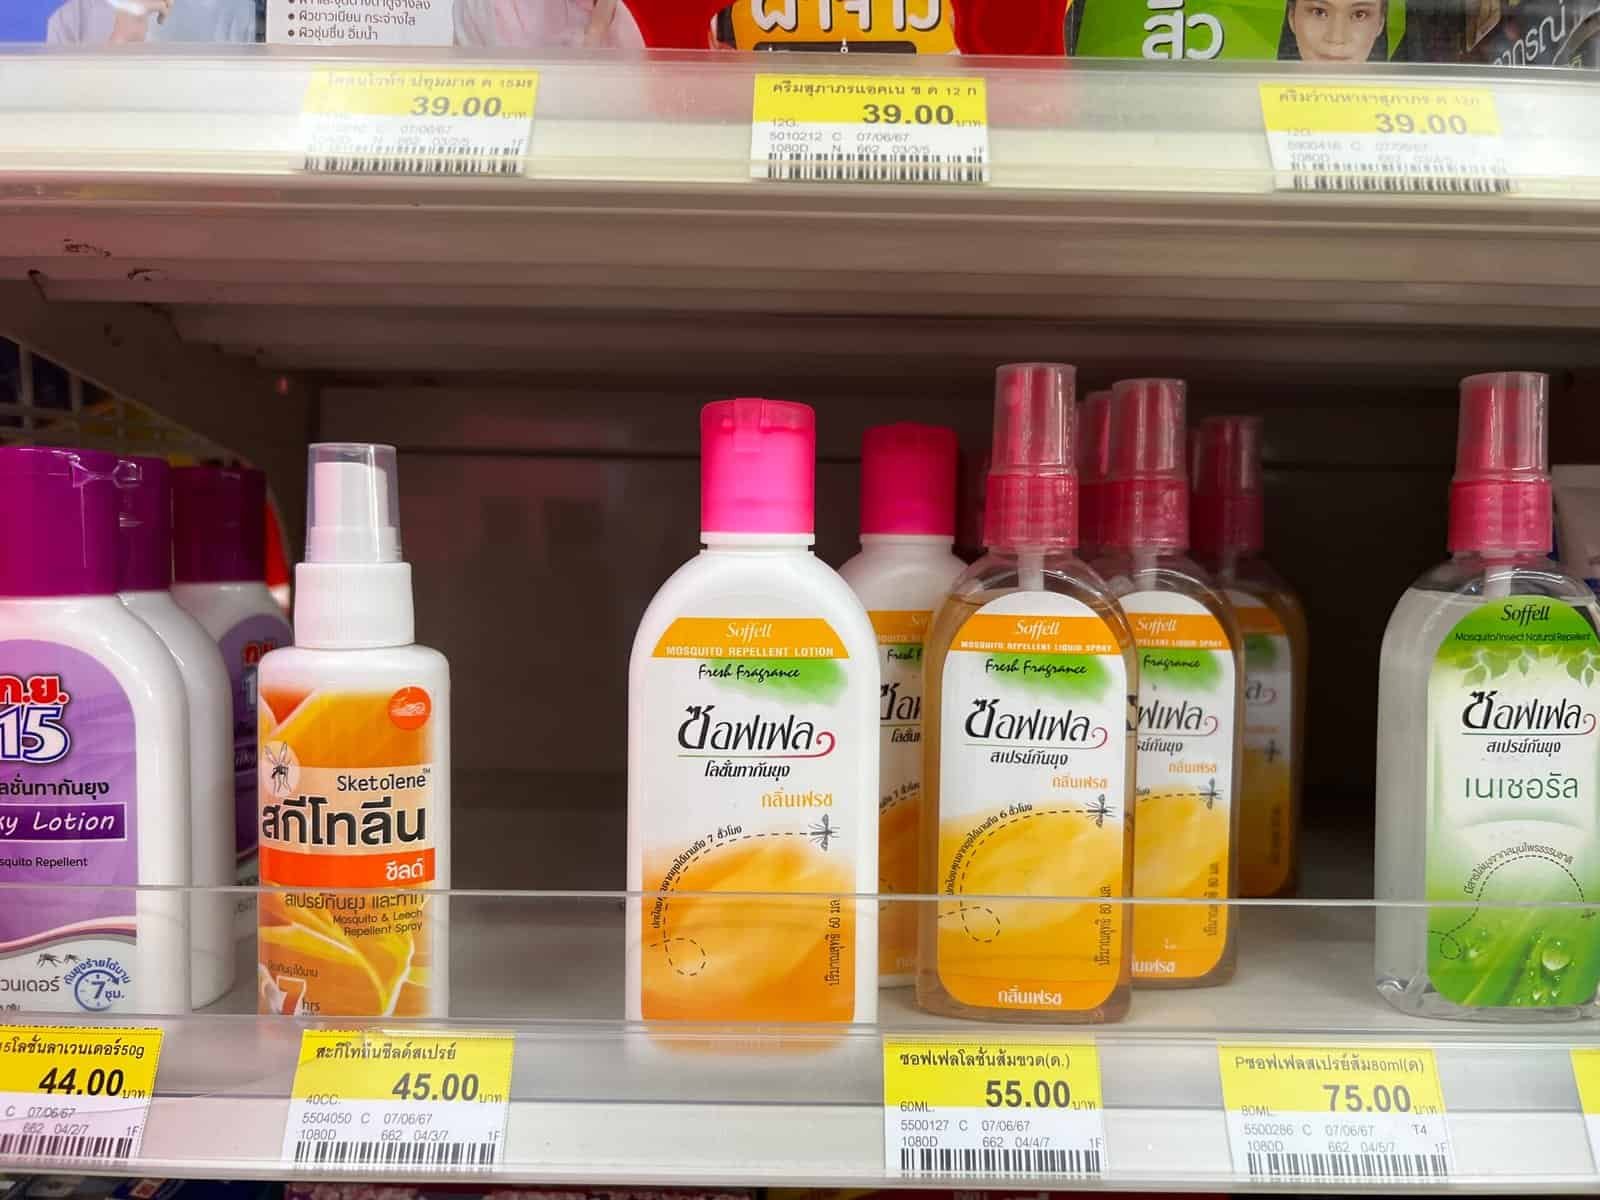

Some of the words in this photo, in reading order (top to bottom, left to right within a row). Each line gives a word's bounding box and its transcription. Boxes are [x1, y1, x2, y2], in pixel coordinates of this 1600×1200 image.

[364, 12, 417, 26] กระจ่างใส
[411, 95, 503, 118] 39.00
[862, 103, 954, 125] 39.00
[1374, 112, 1468, 135] 39.00
[768, 131, 823, 143] 5010212
[831, 131, 843, 142] C
[856, 132, 911, 143] 07/06/67
[770, 143, 809, 153] 1080D
[831, 144, 842, 153] N
[1500, 603, 1551, 626] Soffell
[726, 621, 774, 642] Soffell
[1015, 619, 1061, 640] Soffell
[1135, 618, 1178, 638] Soffell
[665, 646, 723, 657] MOSQUITO
[728, 647, 789, 657] REPELLENT
[794, 648, 834, 657] LOTION
[1006, 642, 1051, 651] REPELLENT
[698, 663, 733, 680] Fresh
[736, 664, 801, 683] Fragrance
[985, 658, 1020, 674] Fresh
[1023, 659, 1089, 678] Fragrance
[1143, 655, 1201, 673] Fragrance
[0, 704, 70, 763] 15
[1486, 738, 1562, 757] สเปรย์กันยุง
[989, 748, 1069, 769] สเปรย์กันยุง
[704, 758, 791, 781] โลชั่นทากันยุง
[0, 774, 110, 800] ลชั่นทากันยุง
[337, 774, 427, 792] Sketolene
[761, 786, 833, 808] กลิ่นเฟรช
[32, 810, 115, 832] Lotion
[262, 796, 427, 848] สกีโทลีน
[999, 809, 1008, 819] 6
[707, 833, 713, 844] 7
[717, 824, 743, 840] ชั่วโมง
[0, 857, 32, 869] squito
[35, 856, 89, 868] Repellent
[385, 858, 425, 881] ชีลด์
[332, 912, 378, 926] Mosquito
[381, 912, 390, 922] &
[393, 909, 424, 921] Leech
[831, 916, 841, 929] 60
[343, 926, 393, 940] Repellent
[394, 923, 424, 937] Spray
[90, 980, 107, 1000] 7
[276, 976, 307, 1016] 7
[302, 998, 321, 1012] hrs
[38, 1067, 125, 1097] 44.00
[121, 1088, 147, 1100] บาท
[391, 1072, 480, 1101] 45.00
[479, 1092, 503, 1105] บาท
[305, 1093, 342, 1105] 40CC.
[985, 1079, 1071, 1109] 55.00
[1072, 1100, 1097, 1111] บาท
[1322, 1084, 1412, 1113] 75.00
[1413, 1105, 1438, 1116] บาท
[5, 1105, 16, 1118] C
[26, 1106, 76, 1120] 07/06/67
[900, 1100, 936, 1113] 60ML.
[302, 1112, 352, 1125] 5504050
[360, 1112, 371, 1125] C
[383, 1113, 433, 1126] 07/06/67
[900, 1119, 950, 1132] 5500127
[958, 1119, 969, 1132] C
[981, 1119, 1031, 1132] 07/06/67
[22, 1122, 45, 1135] 662
[53, 1123, 90, 1136] 04/2/7
[126, 1125, 140, 1138] 1F
[300, 1128, 338, 1141] 1080D
[380, 1129, 403, 1142] 662
[413, 1130, 449, 1142] 04/3/7
[488, 1130, 501, 1142] 1F
[1243, 1123, 1295, 1136] 5500286
[1301, 1123, 1313, 1136] C
[1324, 1124, 1375, 1137] 07/06/67
[1412, 1123, 1428, 1136] T4
[901, 1135, 939, 1148] 1080D
[982, 1136, 1004, 1148] 662
[1014, 1137, 1051, 1149] 04/4/7
[1089, 1138, 1103, 1149] 1F
[1246, 1140, 1284, 1153] 1080D
[1327, 1141, 1350, 1154] 662
[1360, 1141, 1396, 1154] 04/5/7
[1434, 1142, 1448, 1154] 1F
